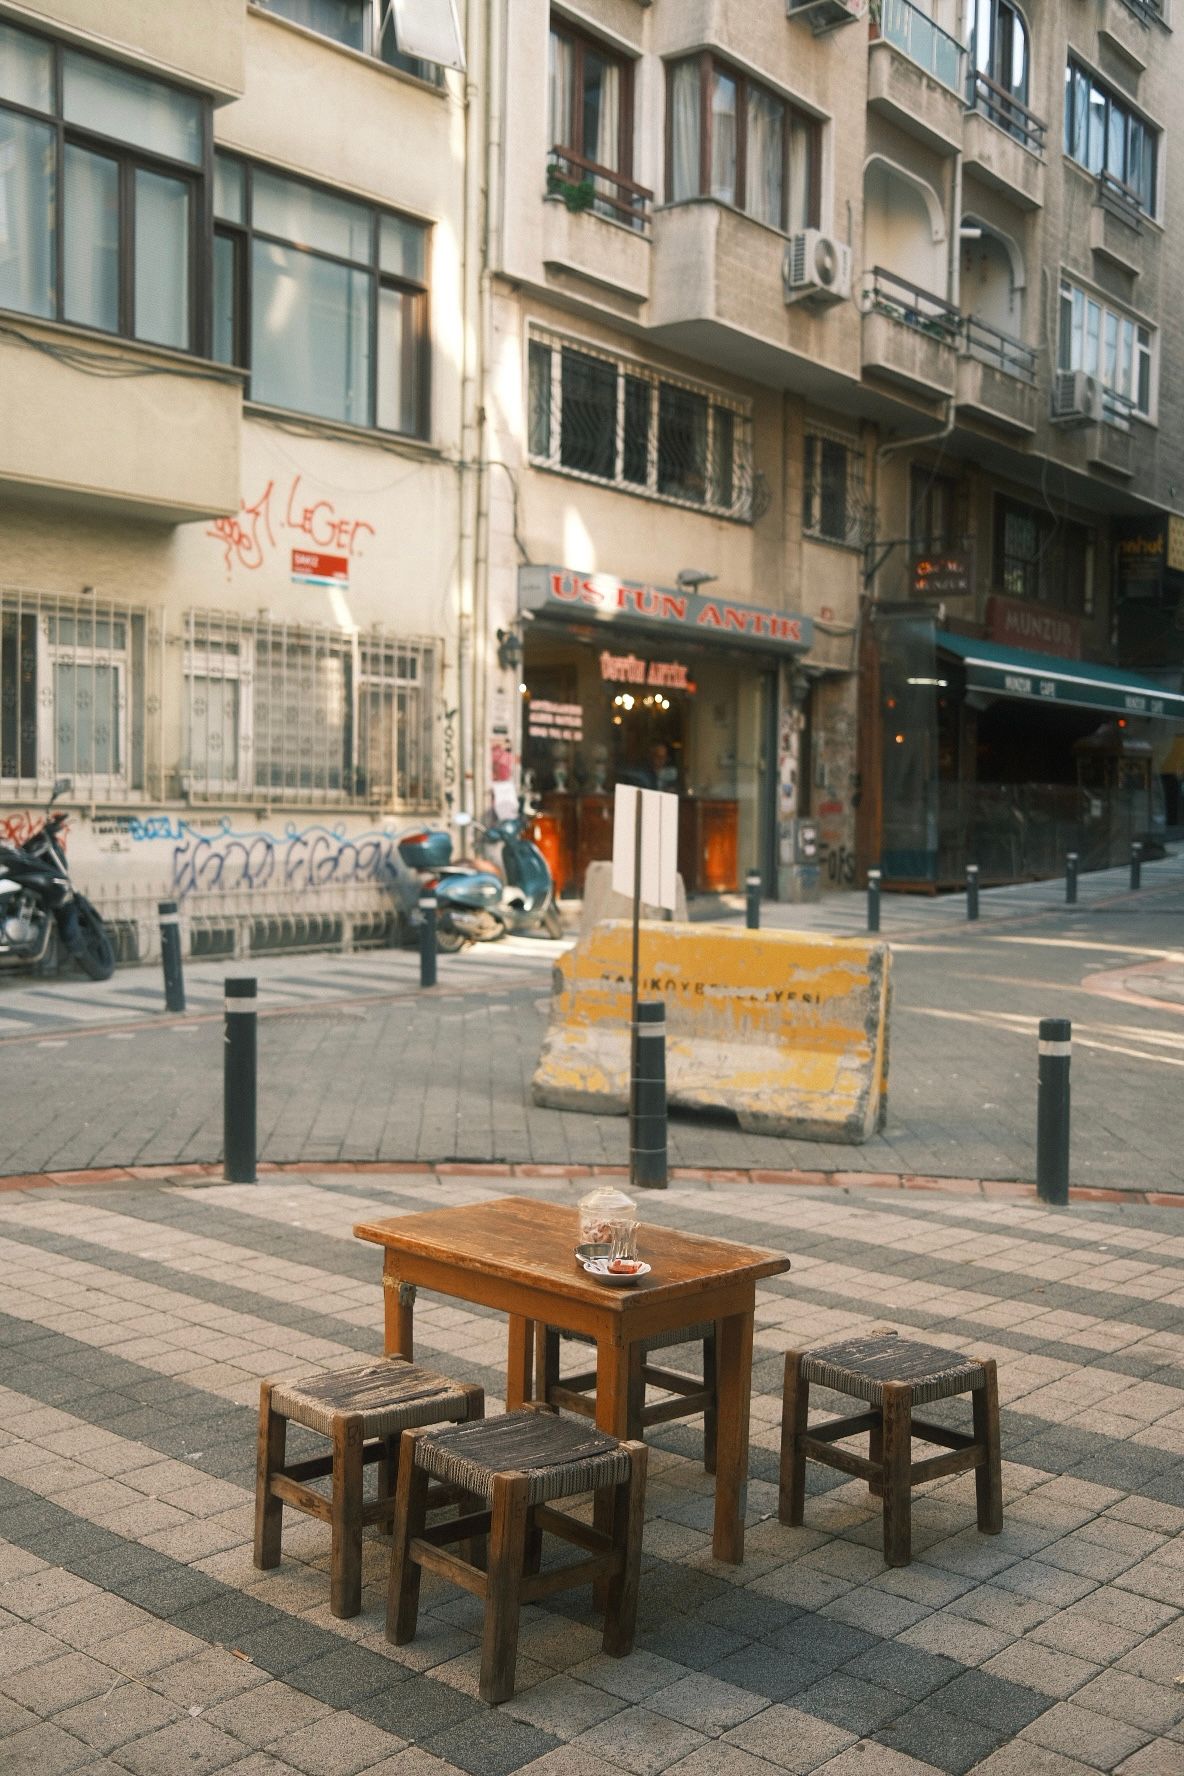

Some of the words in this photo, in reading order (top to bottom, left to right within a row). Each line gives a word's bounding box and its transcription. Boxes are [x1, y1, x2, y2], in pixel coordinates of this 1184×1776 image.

[551, 570, 687, 621] ÜSTÜN
[698, 602, 802, 641] ANTİK
[1005, 608, 1073, 645] MUNZUR
